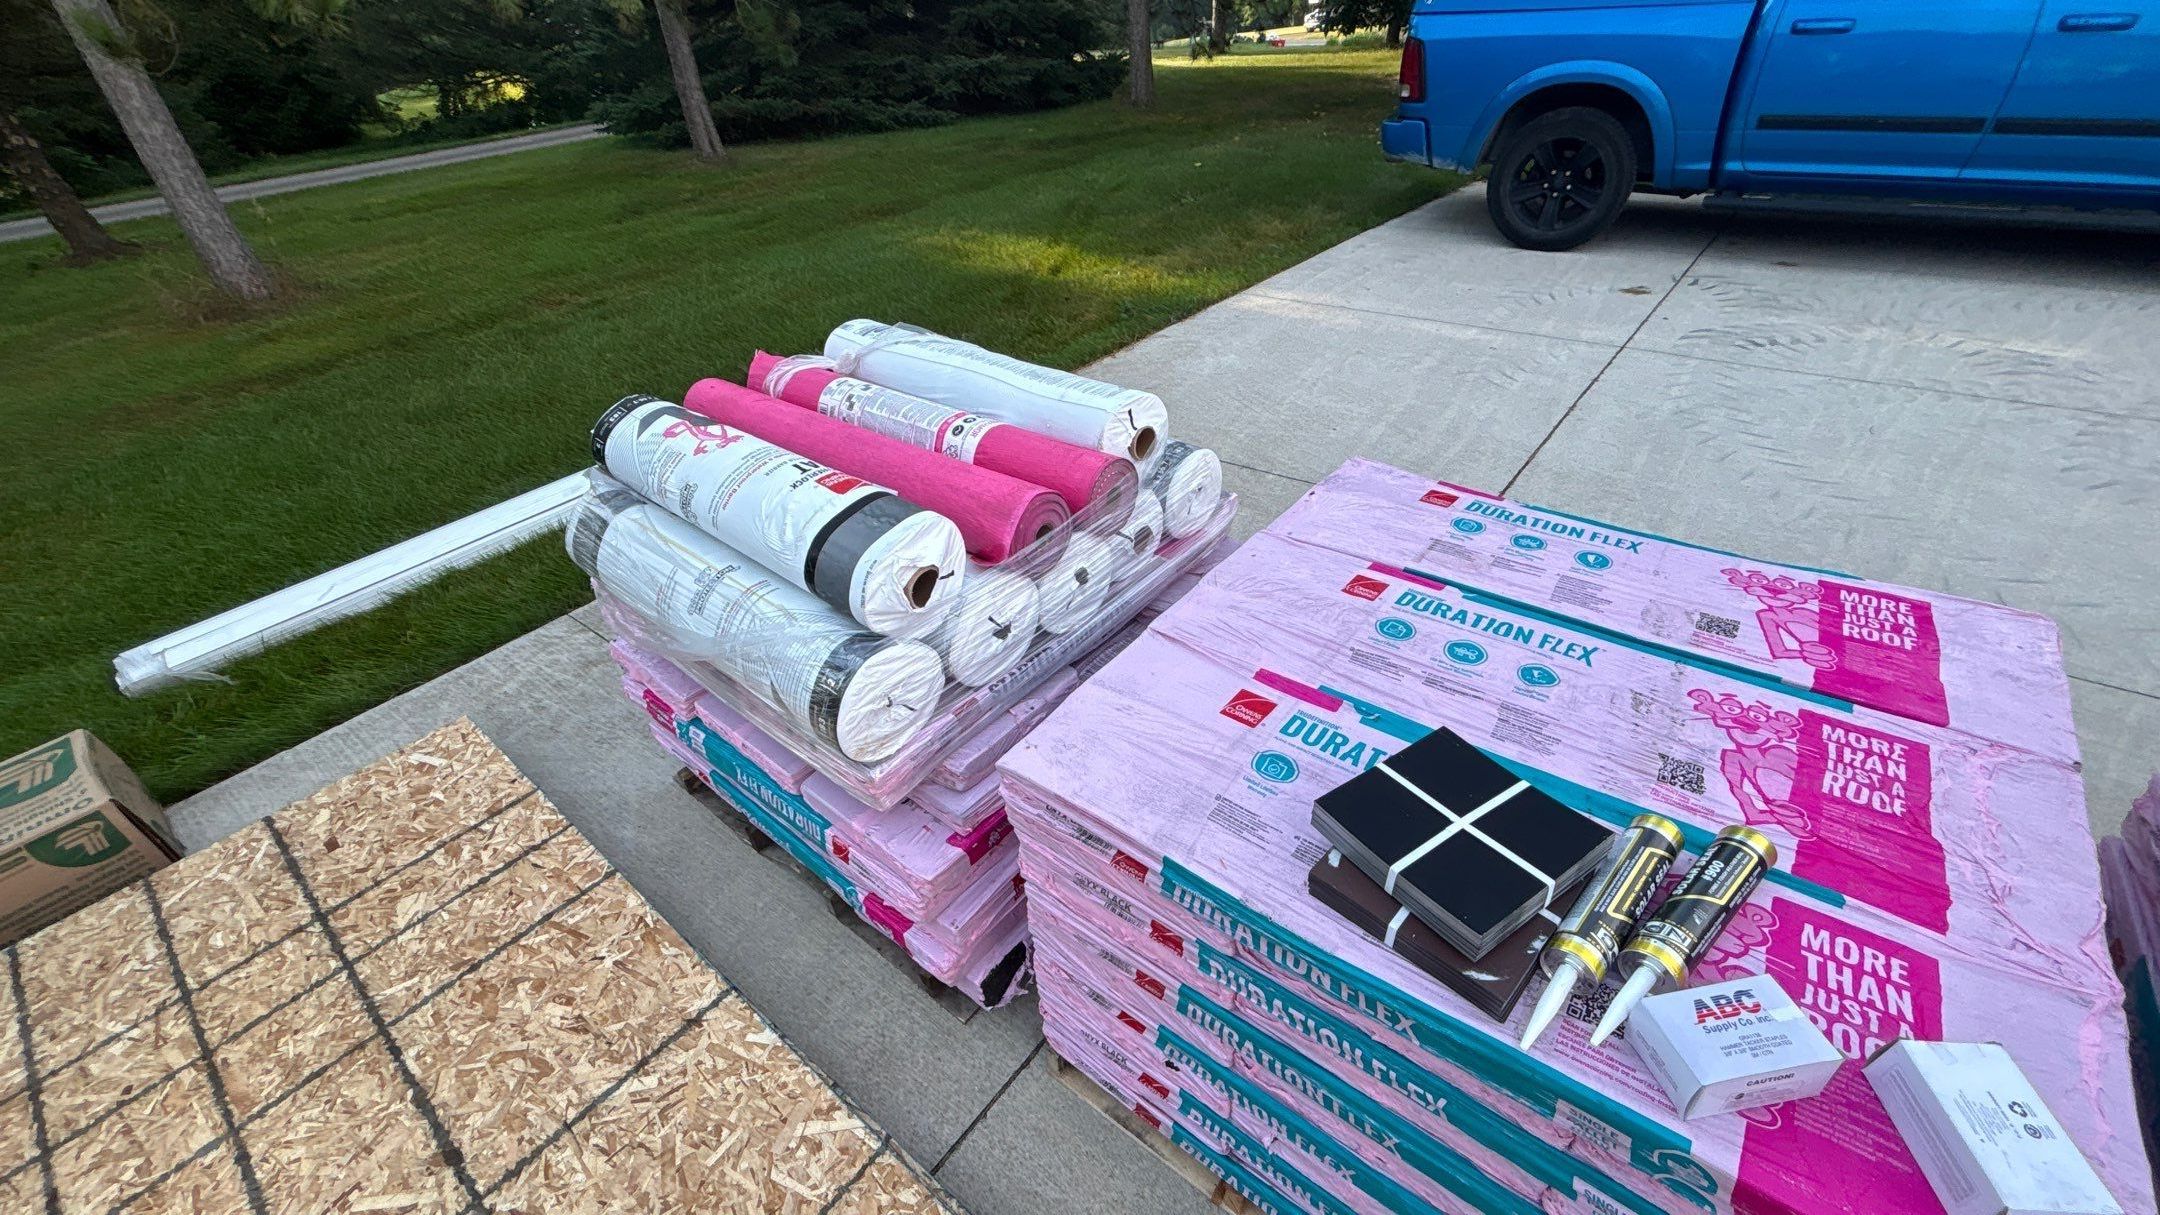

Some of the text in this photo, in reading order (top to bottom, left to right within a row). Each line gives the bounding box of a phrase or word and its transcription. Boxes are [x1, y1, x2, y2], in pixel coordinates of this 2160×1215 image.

[792, 459, 818, 476] AT
[1464, 500, 1586, 539] DURATION
[1590, 531, 1644, 554] FLEX
[1840, 590, 1912, 614] MORE
[1842, 602, 1915, 627] THAN
[1393, 591, 1535, 646] DURATION
[1538, 632, 1600, 667] FLEX
[1842, 621, 1920, 650] ROOF
[1844, 612, 1918, 638] JUST A
[1225, 706, 1260, 725] CORNING
[1235, 704, 1262, 720] OWENS
[1279, 714, 1388, 773] DURAT
[1822, 724, 1909, 763] MORE
[1826, 740, 1907, 782] THAN
[1822, 771, 1907, 817] ROOF
[1828, 759, 1906, 798] JUST A
[1673, 844, 1721, 896] SOLAR SEAL
[1100, 887, 1132, 912] BLACK
[1801, 923, 1911, 987] MORE
[1801, 950, 1914, 1023] THAN
[1341, 985, 1419, 1046] FLEX
[1694, 989, 1762, 1025] ABC
[1702, 1020, 1738, 1034] Supply
[1738, 1017, 1755, 1028] Co.
[1801, 983, 1882, 1033] JUST
[1101, 1042, 1128, 1065] BLACK
[1187, 1002, 1330, 1107] DURATION
[1746, 1073, 1795, 1086] CAUTION!
[1180, 1137, 1279, 1215] DURATIO
